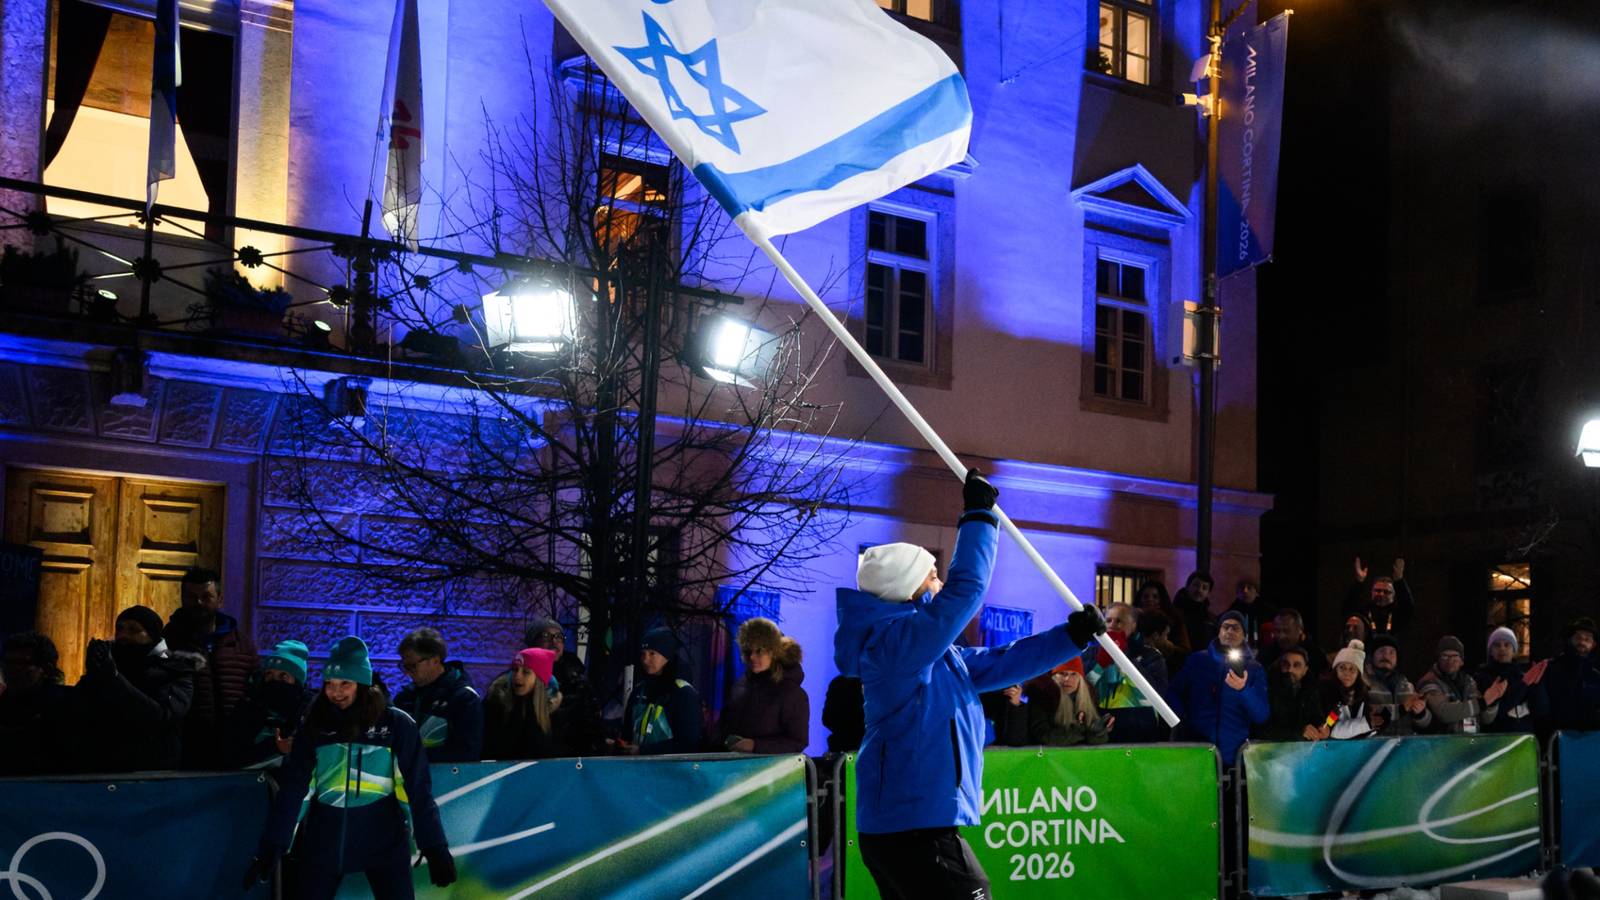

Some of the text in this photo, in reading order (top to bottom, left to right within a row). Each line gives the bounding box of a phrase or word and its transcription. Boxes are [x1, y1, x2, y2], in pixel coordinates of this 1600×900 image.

[1240, 44, 1257, 260] MILANO CORTINA 2026
[0, 552, 37, 583] OME
[984, 610, 1032, 633] WELCOME
[980, 786, 1097, 816] MILANO
[984, 818, 1126, 849] CORTINA
[1009, 852, 1075, 881] 2026
